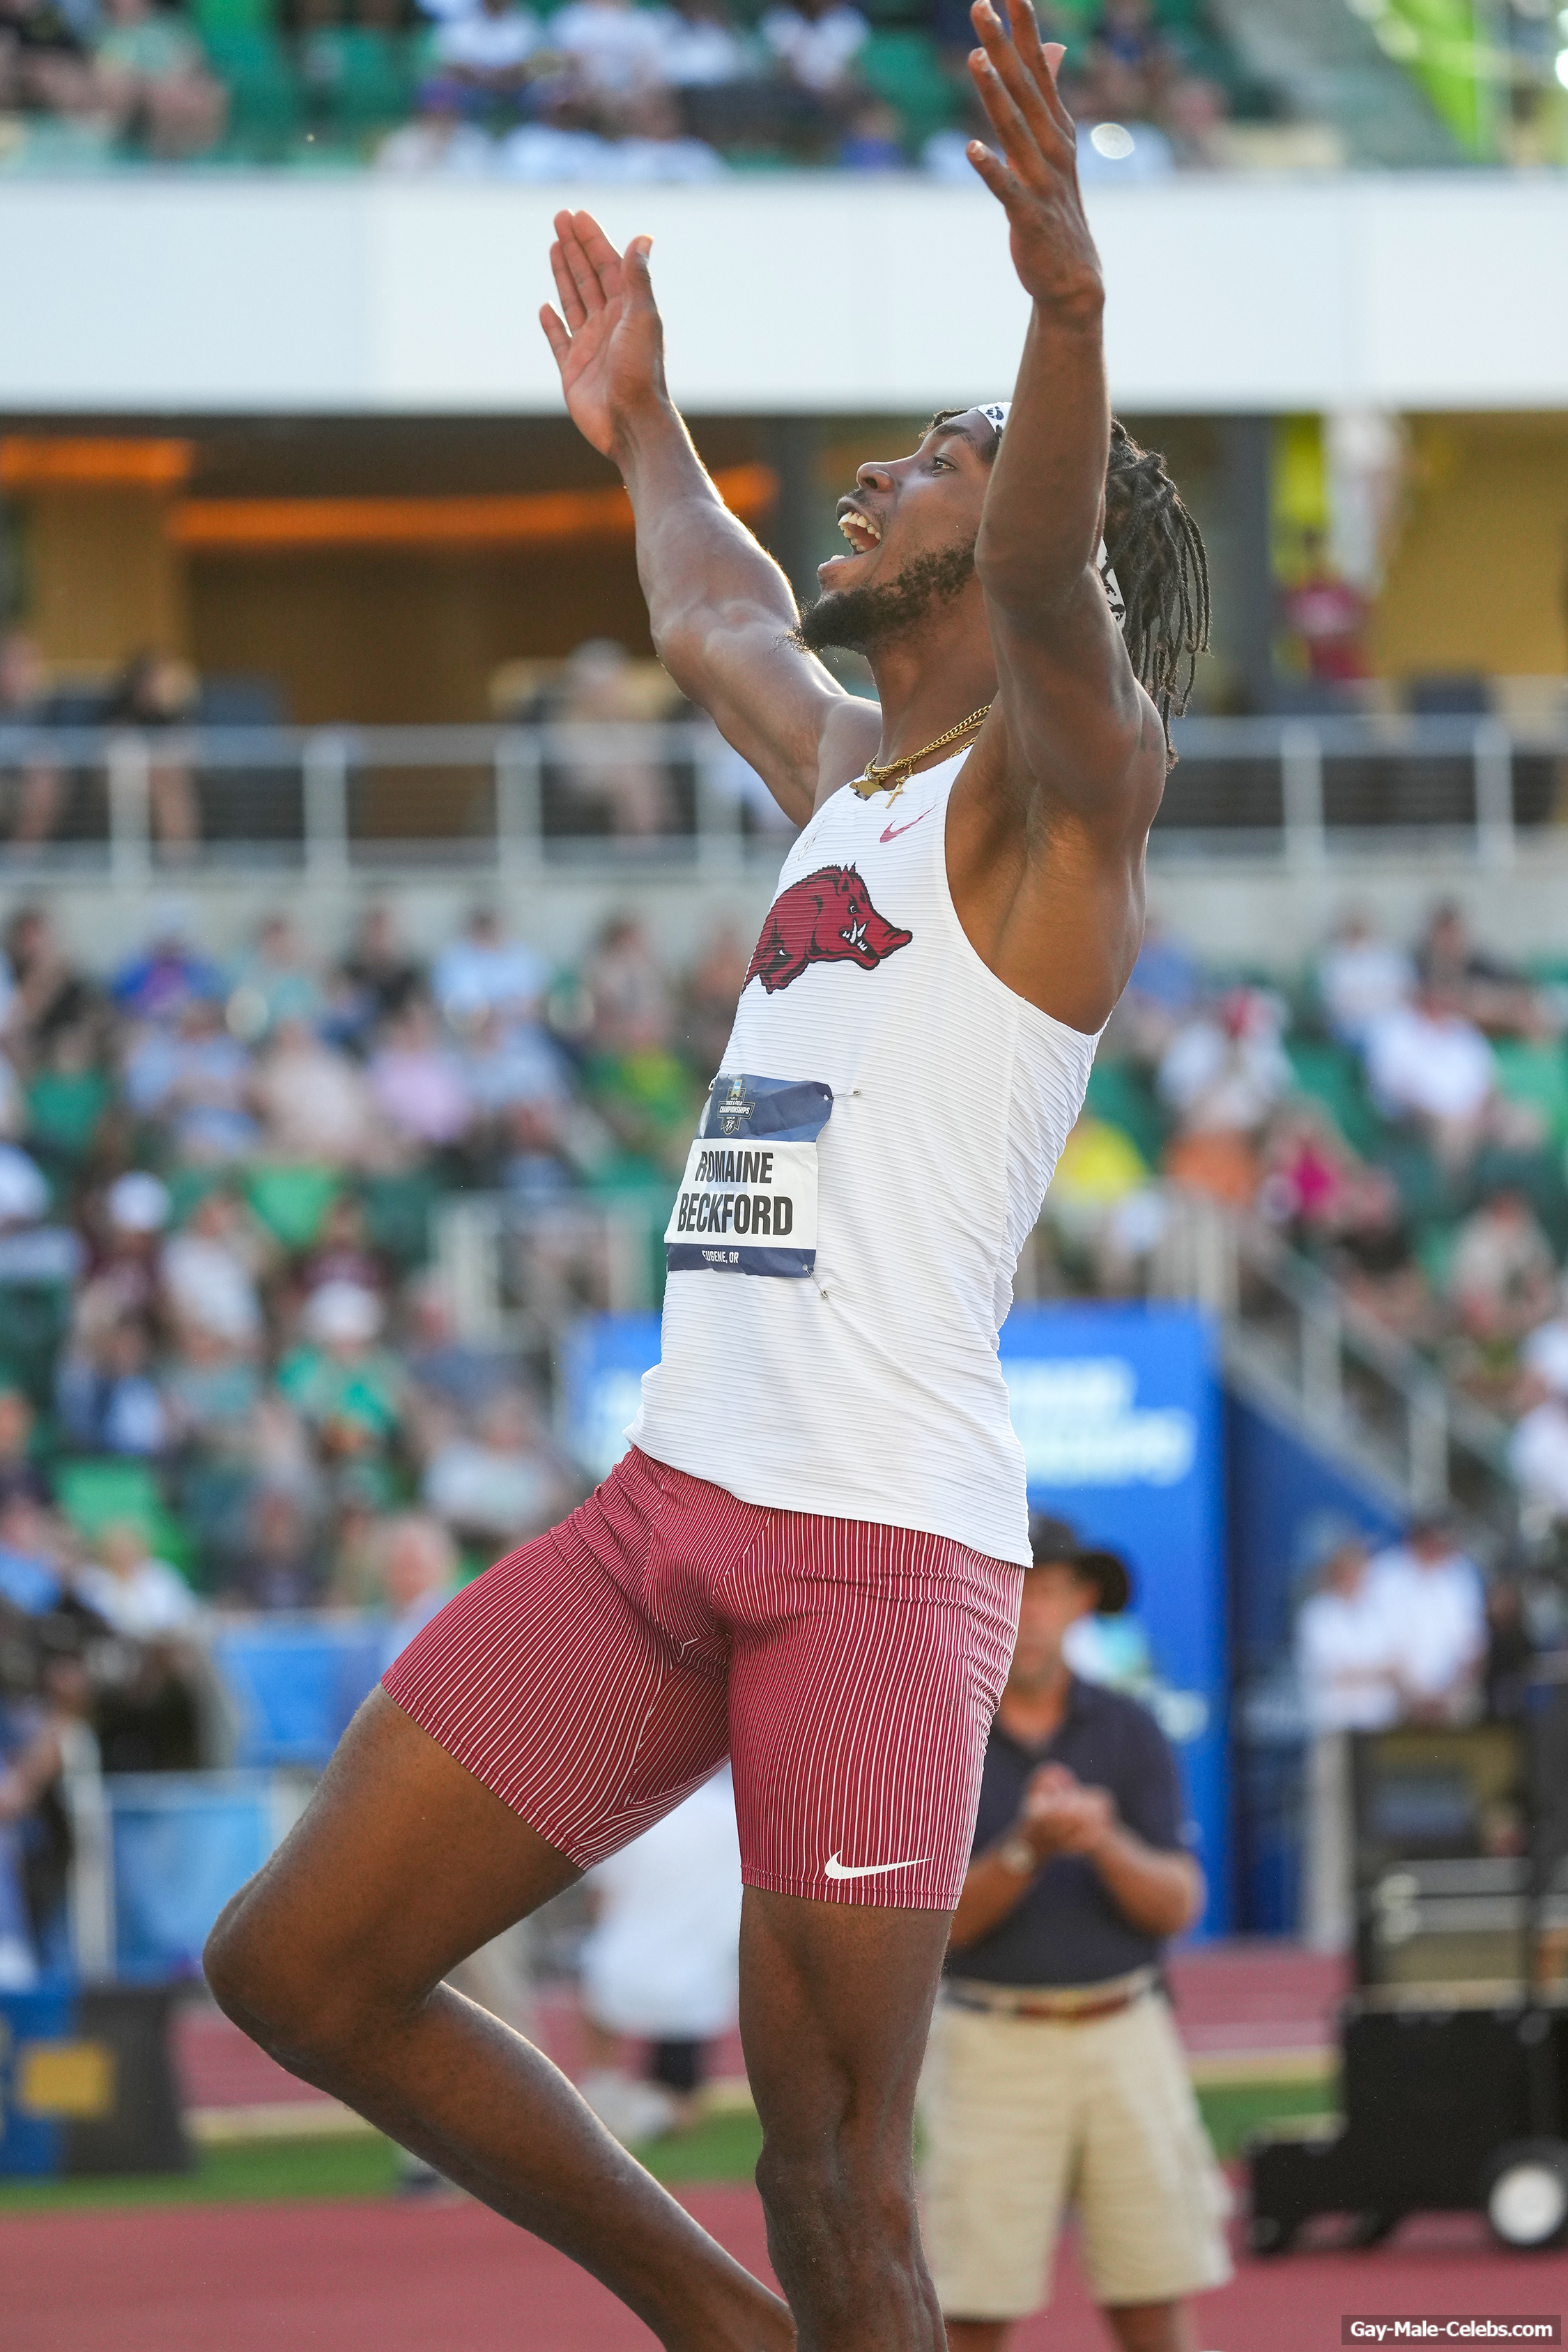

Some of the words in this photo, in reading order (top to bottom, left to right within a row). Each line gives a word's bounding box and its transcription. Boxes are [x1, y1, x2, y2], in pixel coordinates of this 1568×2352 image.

[719, 1106, 750, 1114] CHAMPIONSHIPS
[695, 1151, 774, 1183] ROMAINE
[677, 1193, 793, 1236] BECKFORD
[702, 1250, 728, 1263] EUGENE,
[729, 1252, 739, 1263] OR
